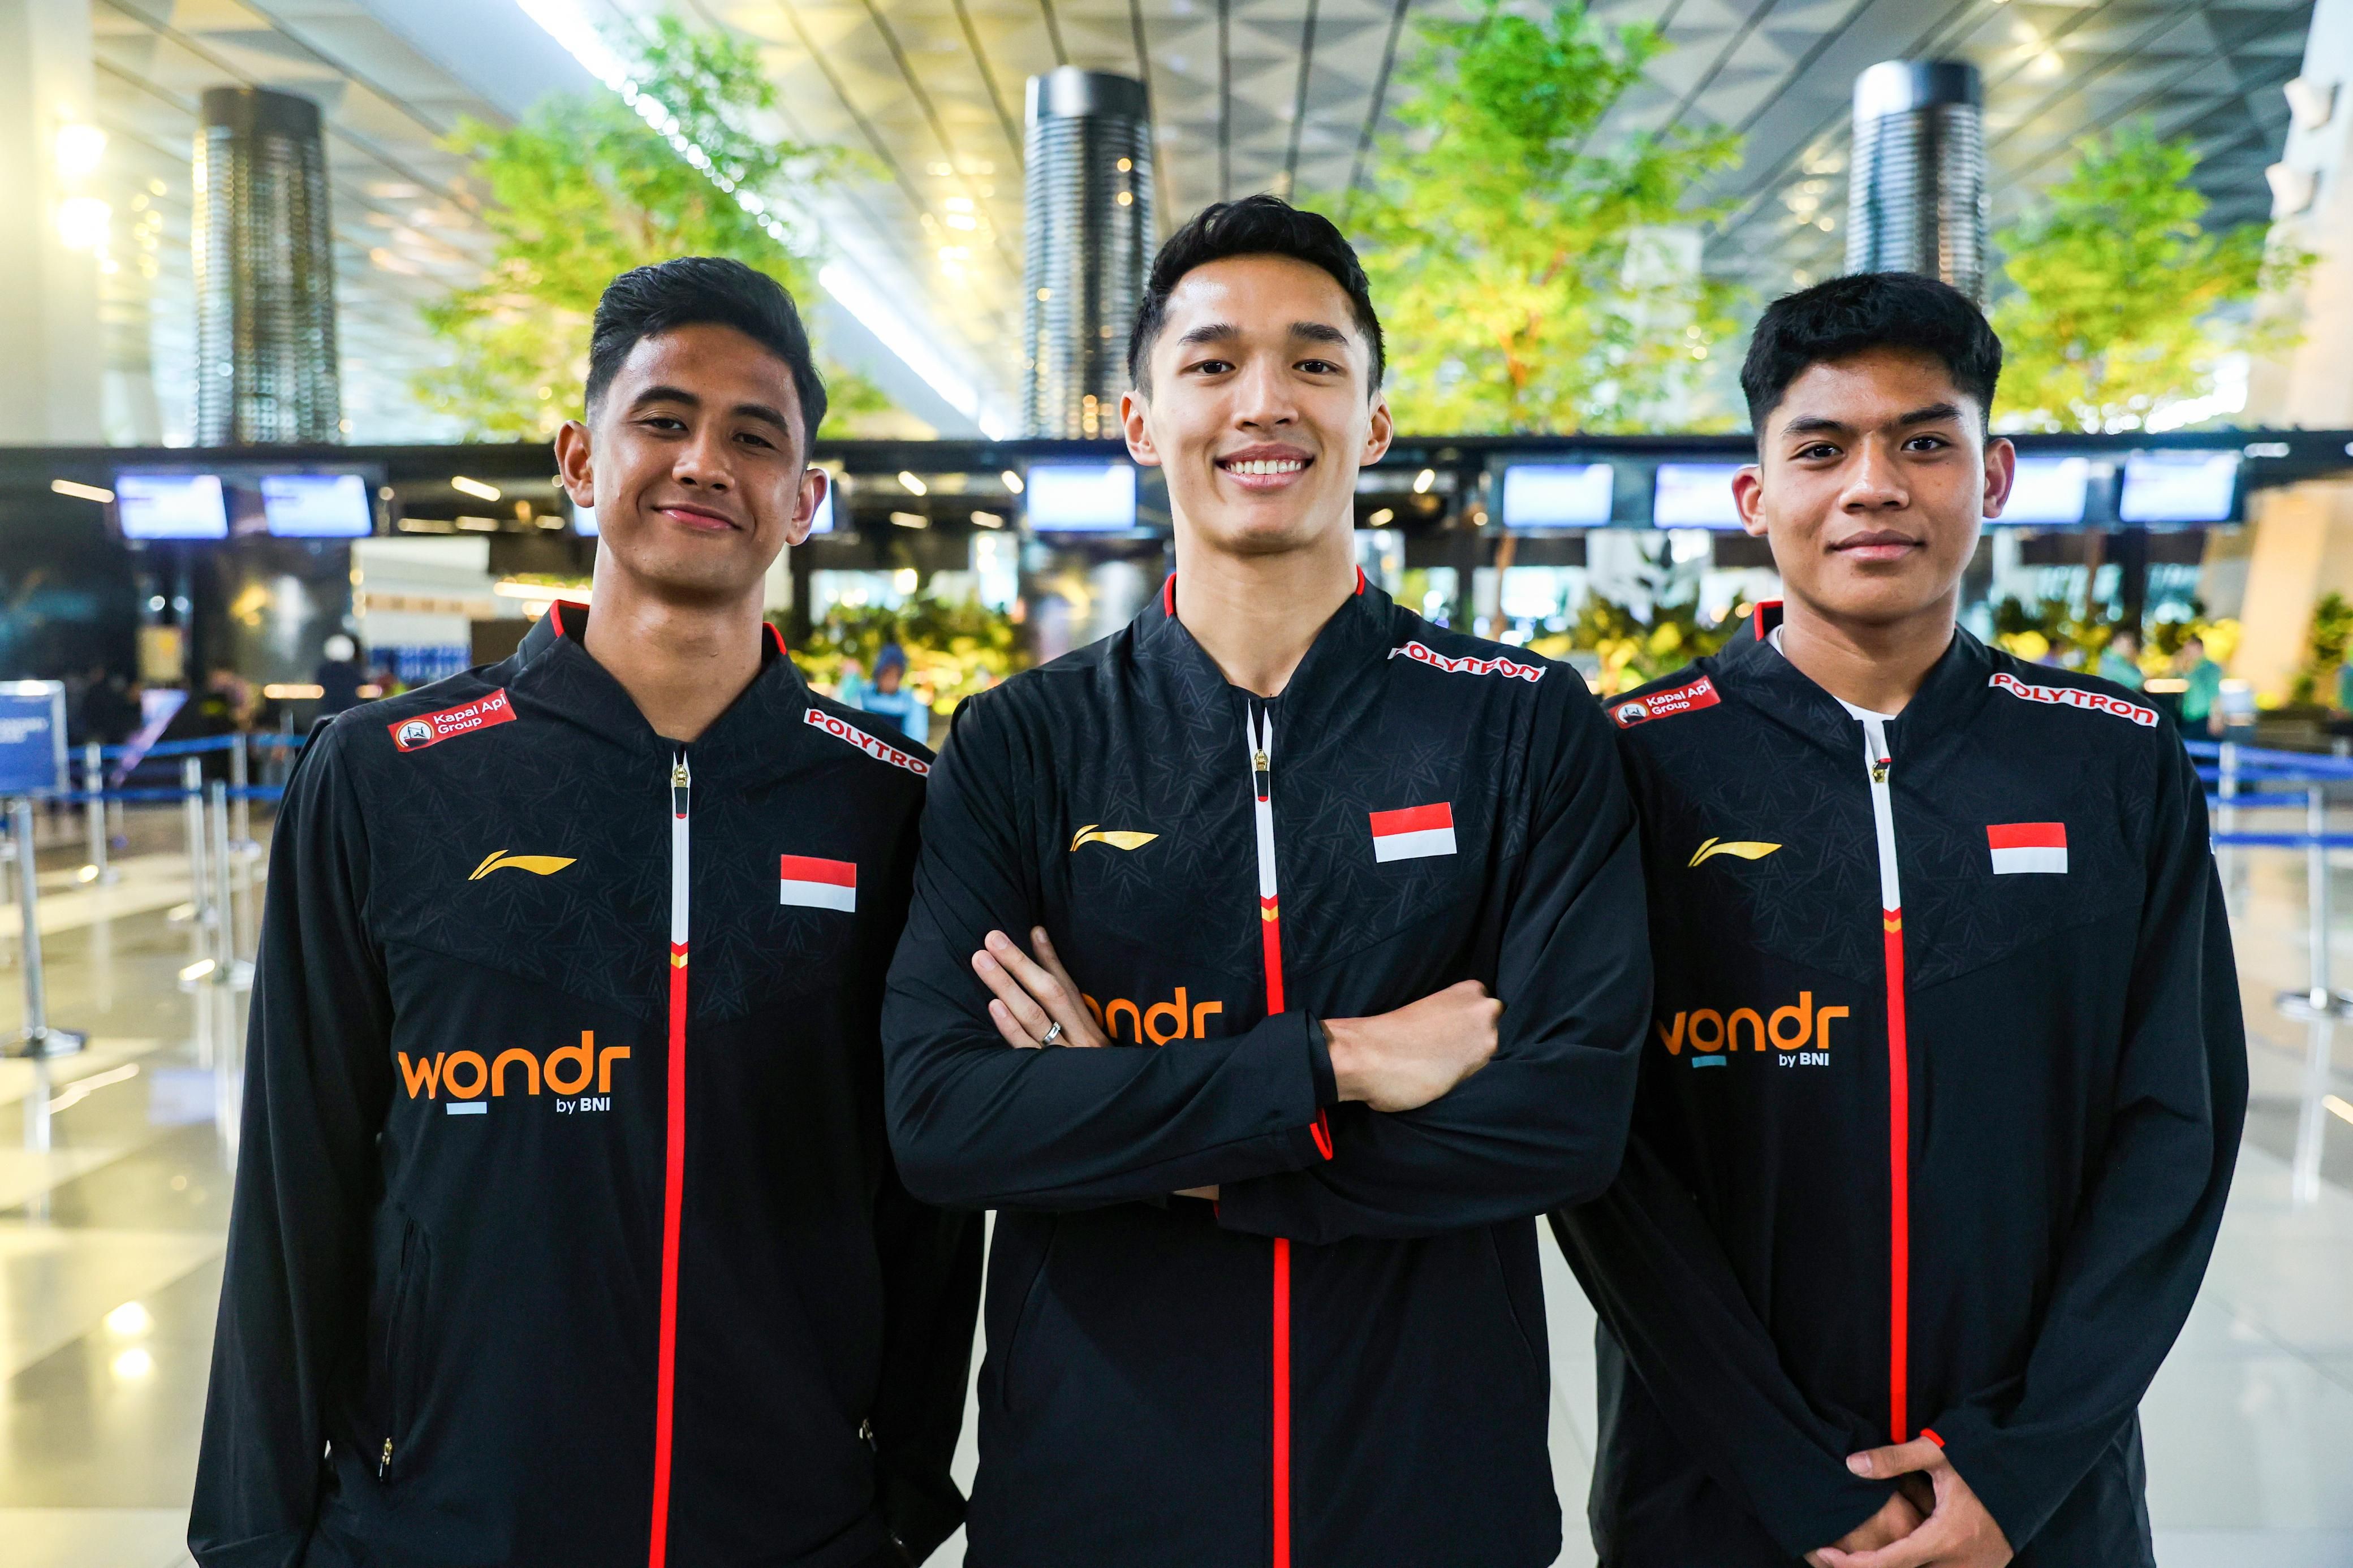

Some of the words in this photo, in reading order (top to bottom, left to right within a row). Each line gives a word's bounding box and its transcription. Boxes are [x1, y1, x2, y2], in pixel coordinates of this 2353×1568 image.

[1646, 691, 1687, 707] Kapal
[1688, 680, 1712, 698] Api
[1994, 675, 2153, 723] POLYTRON
[433, 705, 479, 724] Kapal
[481, 694, 507, 713] Api
[1651, 701, 1691, 715] Group
[437, 718, 482, 734] Group
[808, 711, 928, 774] POLYTRO
[1081, 987, 1222, 1046] ndr
[398, 1030, 631, 1100] wondr
[1778, 1054, 1796, 1068] by
[1799, 1052, 1830, 1066] BNI
[556, 1098, 576, 1115] by
[580, 1097, 610, 1112] BNI
